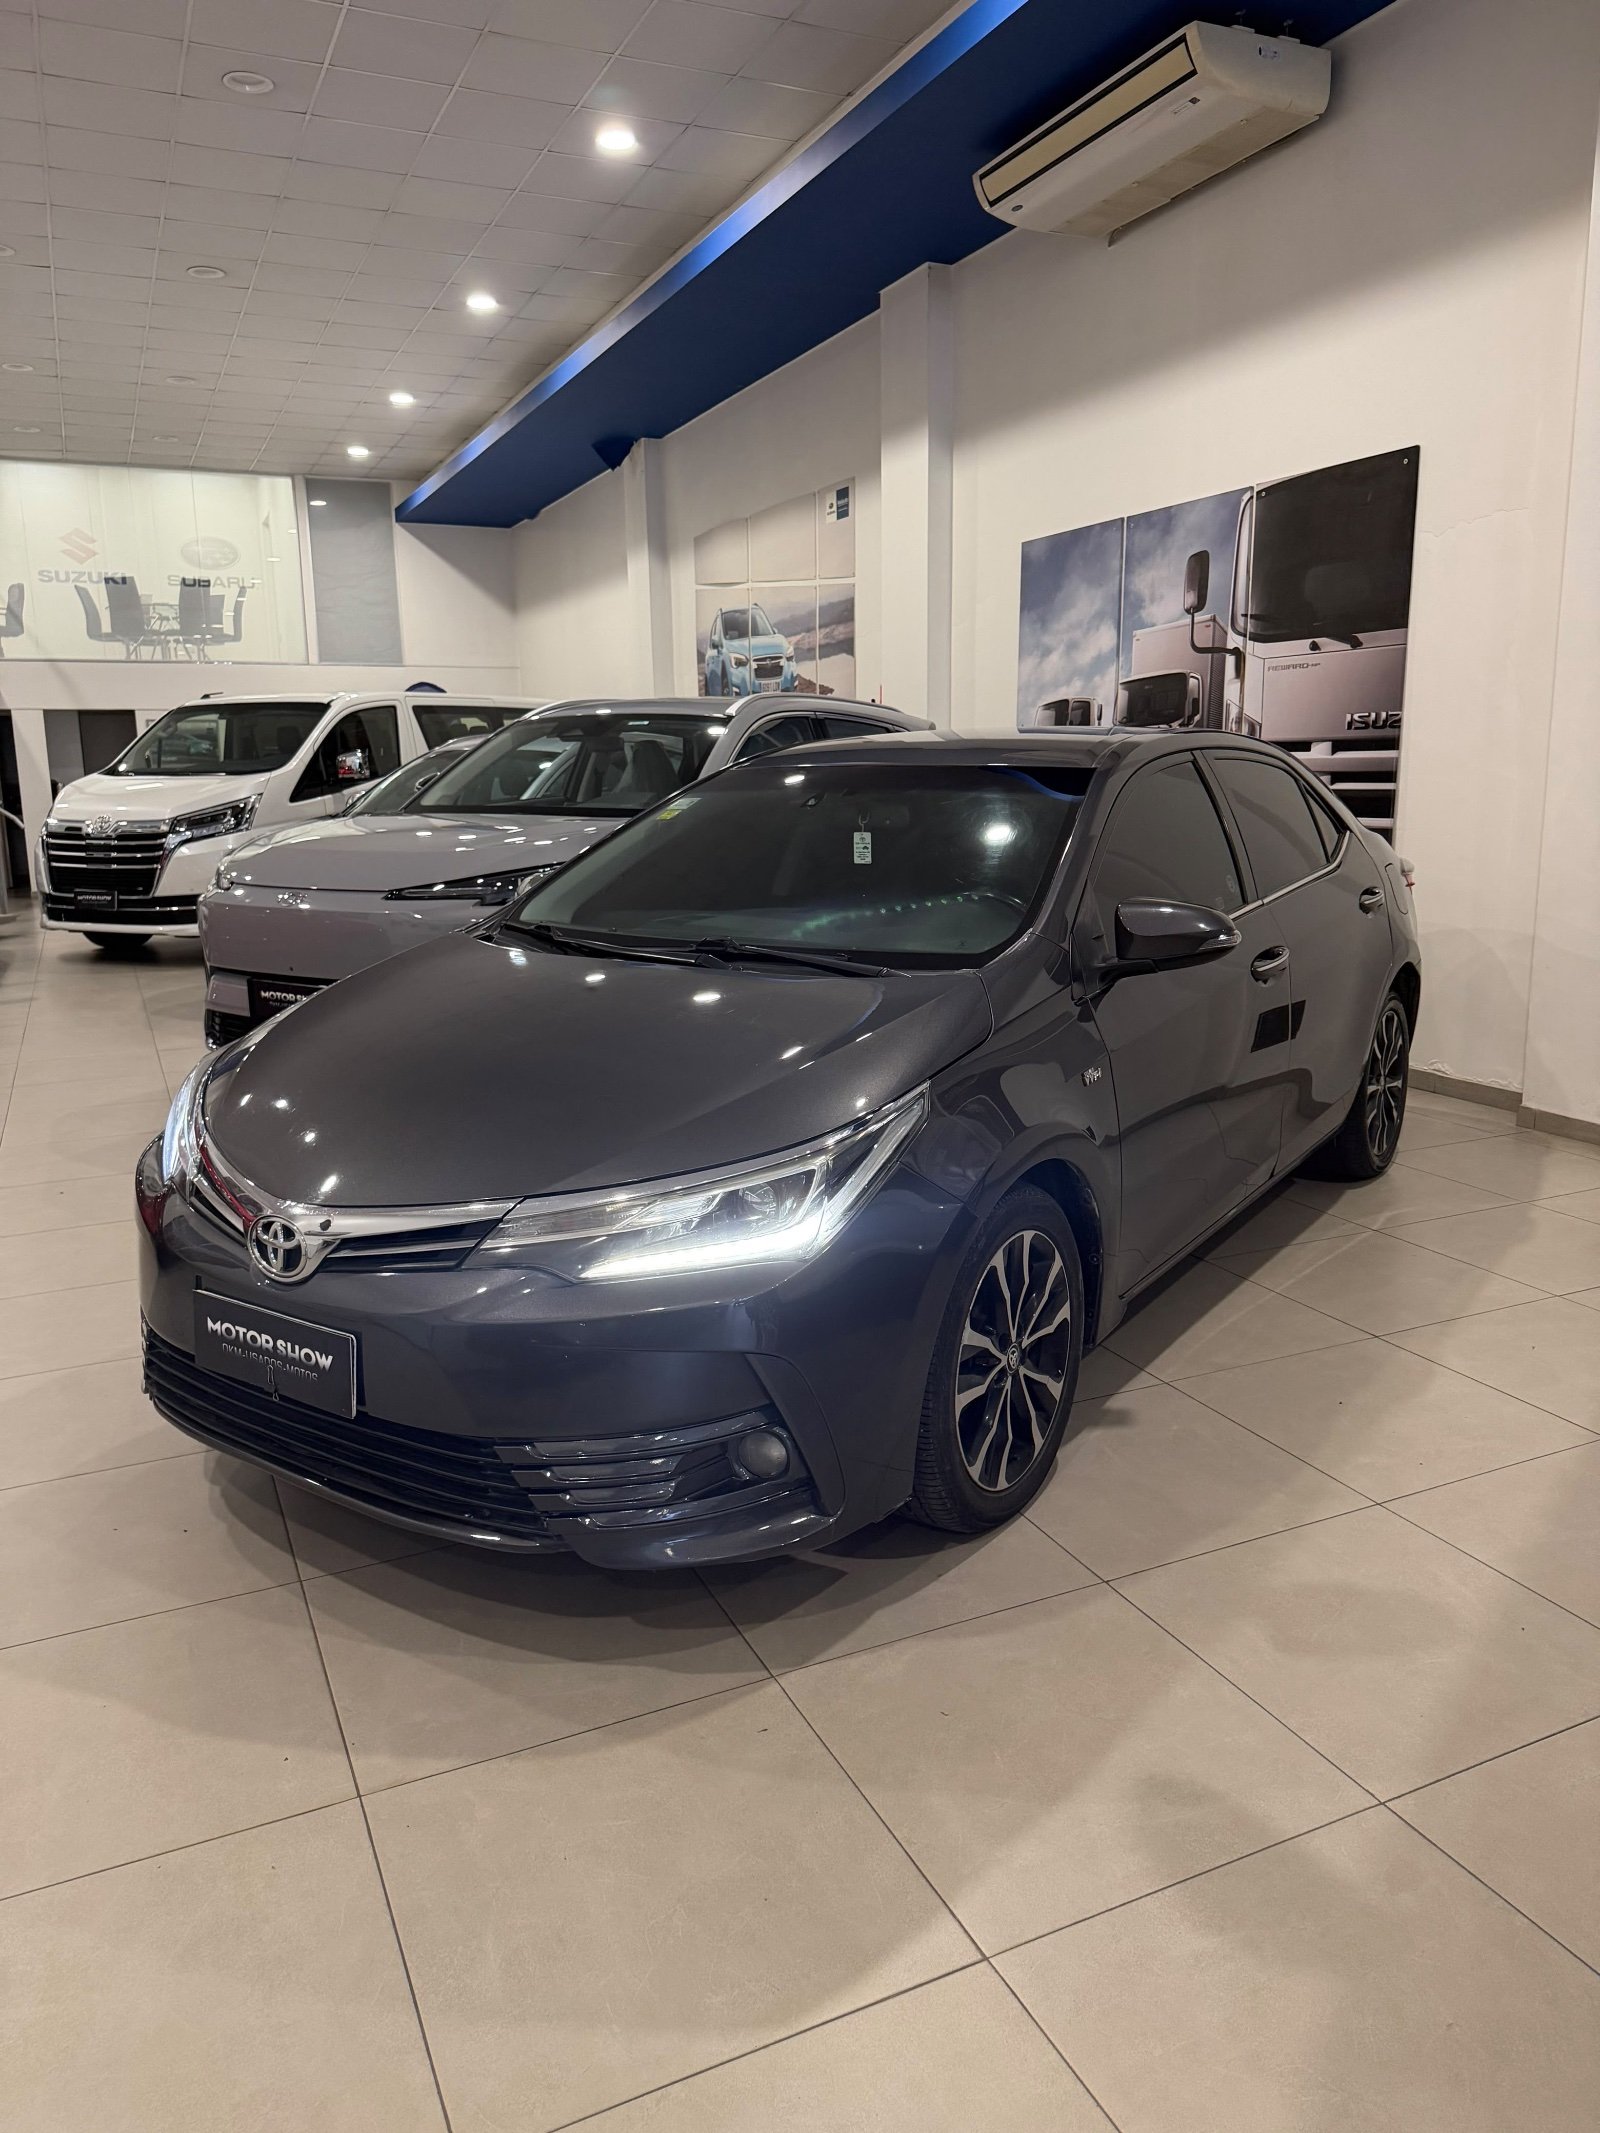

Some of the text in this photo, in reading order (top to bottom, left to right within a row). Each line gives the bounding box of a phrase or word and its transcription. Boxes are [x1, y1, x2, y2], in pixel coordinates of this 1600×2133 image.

[37, 569, 128, 585] SUZUKI
[167, 574, 257, 589] SUBARU
[260, 990, 296, 1002] MOTOR
[206, 1316, 333, 1372] MOTOR SHOW
